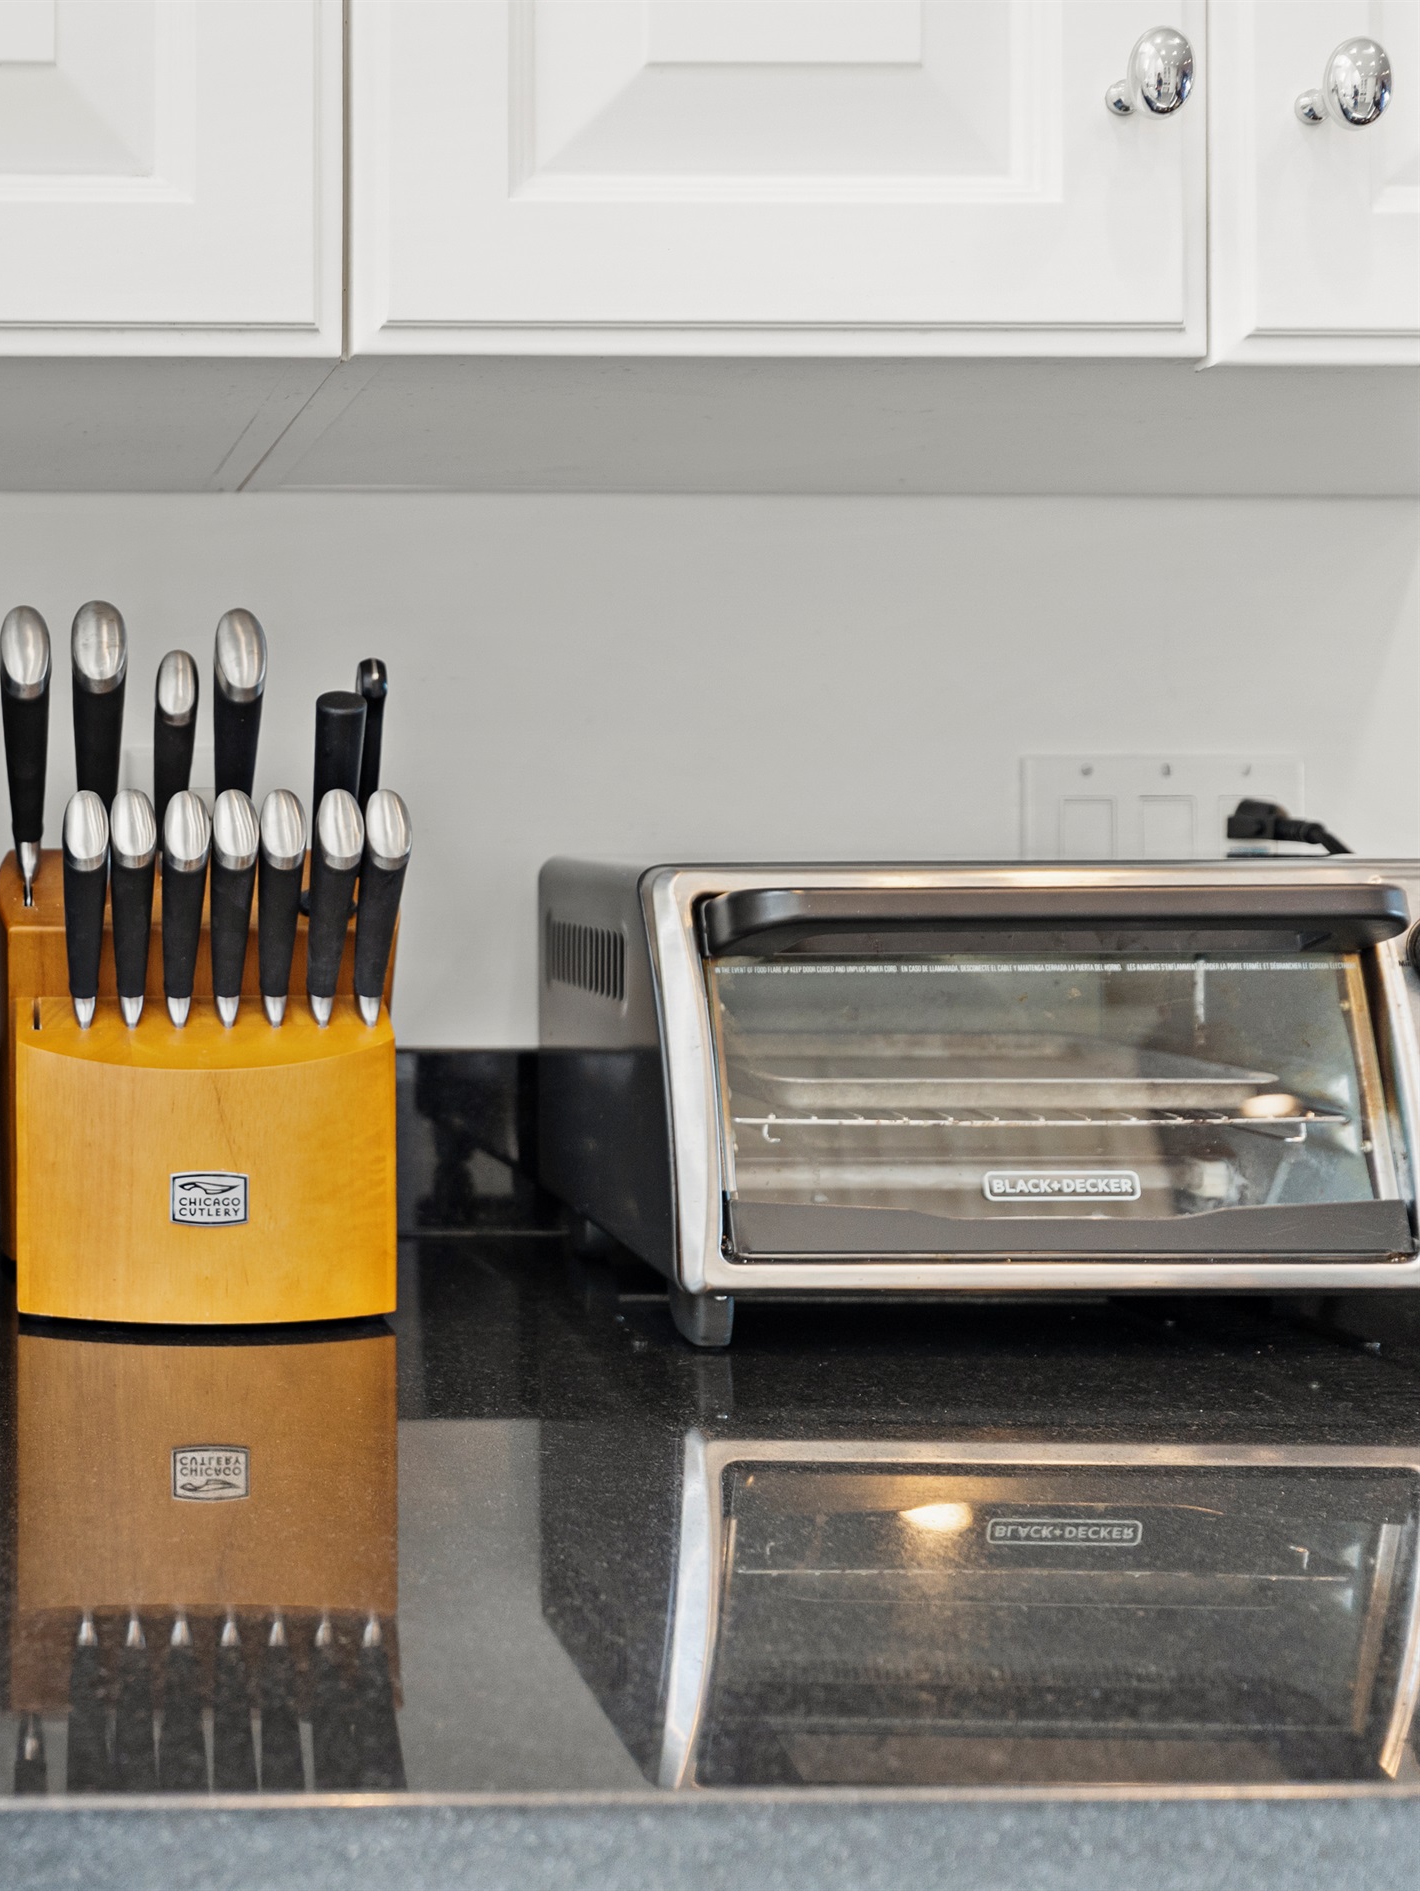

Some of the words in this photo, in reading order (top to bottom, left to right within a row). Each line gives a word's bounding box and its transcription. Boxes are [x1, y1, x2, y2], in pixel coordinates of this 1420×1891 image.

[992, 1178, 1133, 1194] BLACK+DECKER
[179, 1197, 241, 1207] CHICAGO
[179, 1207, 240, 1217] CUTLERY
